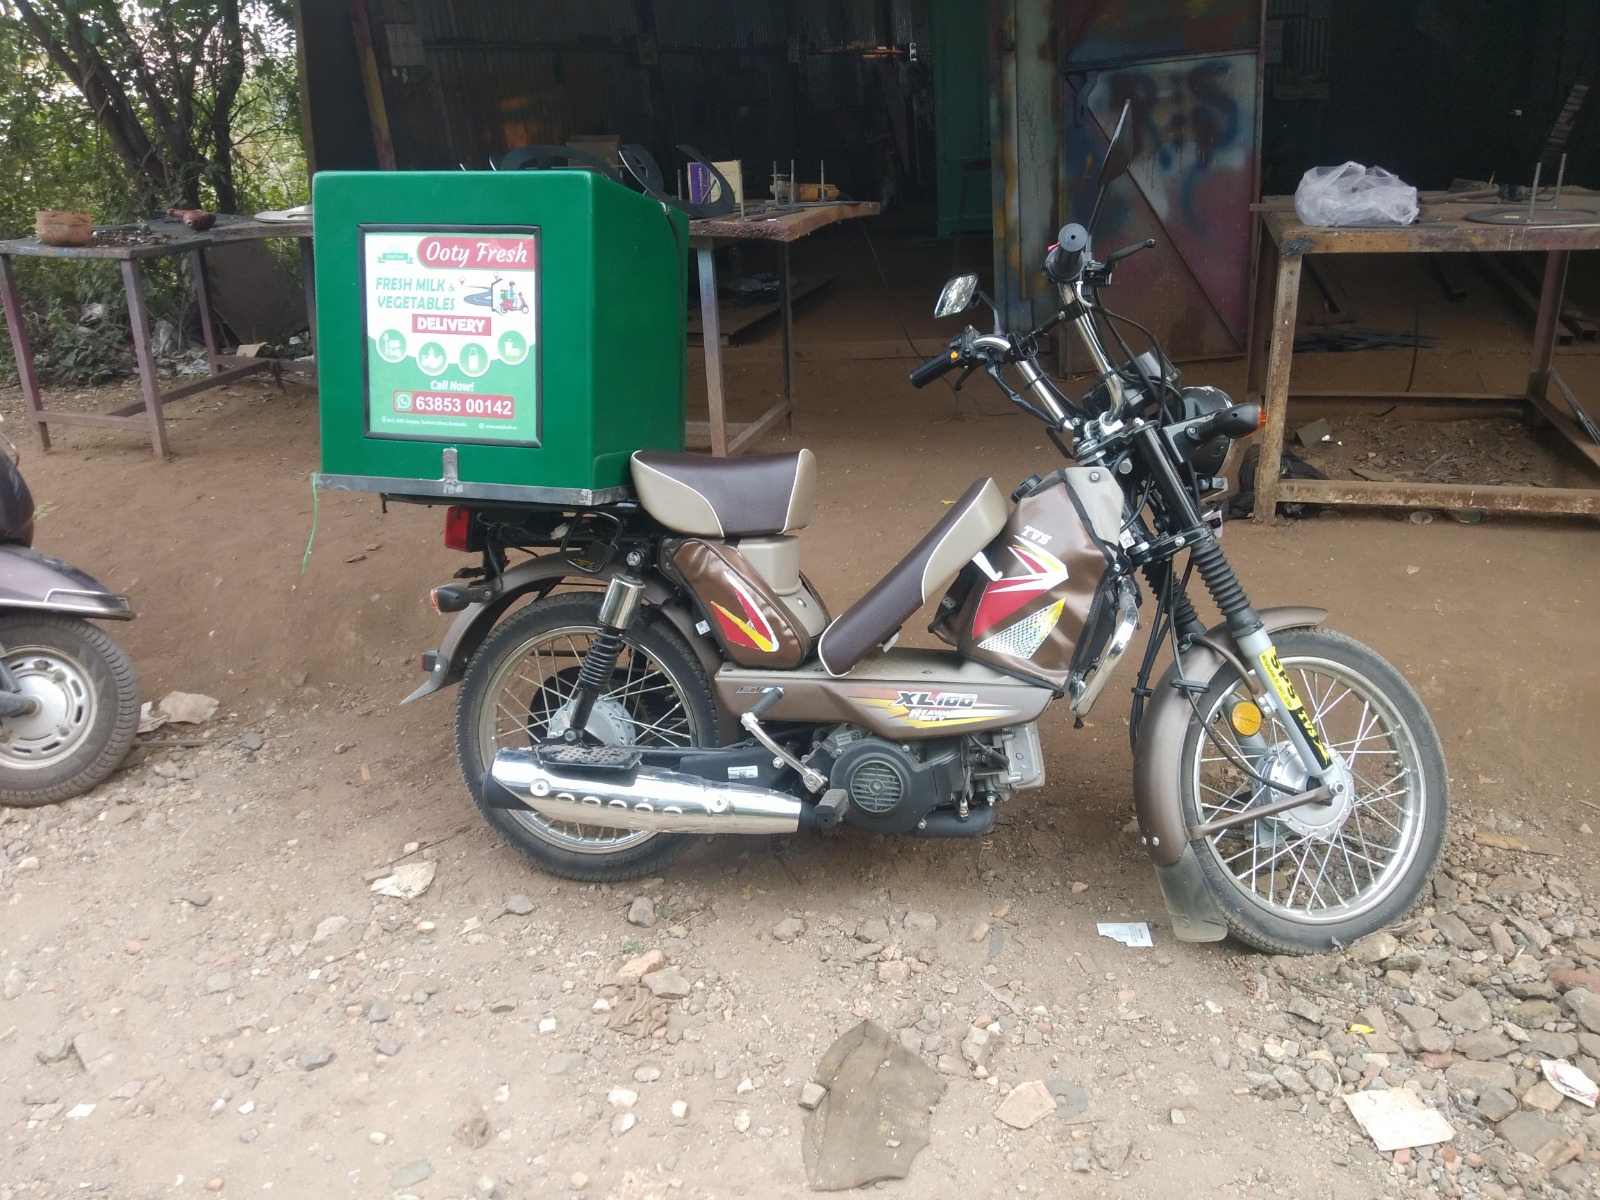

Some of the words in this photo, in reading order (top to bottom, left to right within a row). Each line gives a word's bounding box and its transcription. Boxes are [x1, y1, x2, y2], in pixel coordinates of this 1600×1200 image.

[426, 241, 470, 268] Ooty
[476, 241, 527, 263] Fresh
[375, 277, 413, 292] FRESH
[416, 278, 446, 292] MILK
[377, 295, 455, 311] VEGETABLES
[417, 316, 486, 333] DELIVERY
[430, 379, 449, 391] Call
[449, 380, 475, 392] Now!
[415, 396, 461, 413] 63853
[465, 398, 512, 415] 00142
[1021, 525, 1053, 545] TVS
[1270, 654, 1296, 700] SPS
[1297, 709, 1319, 739] TVS
